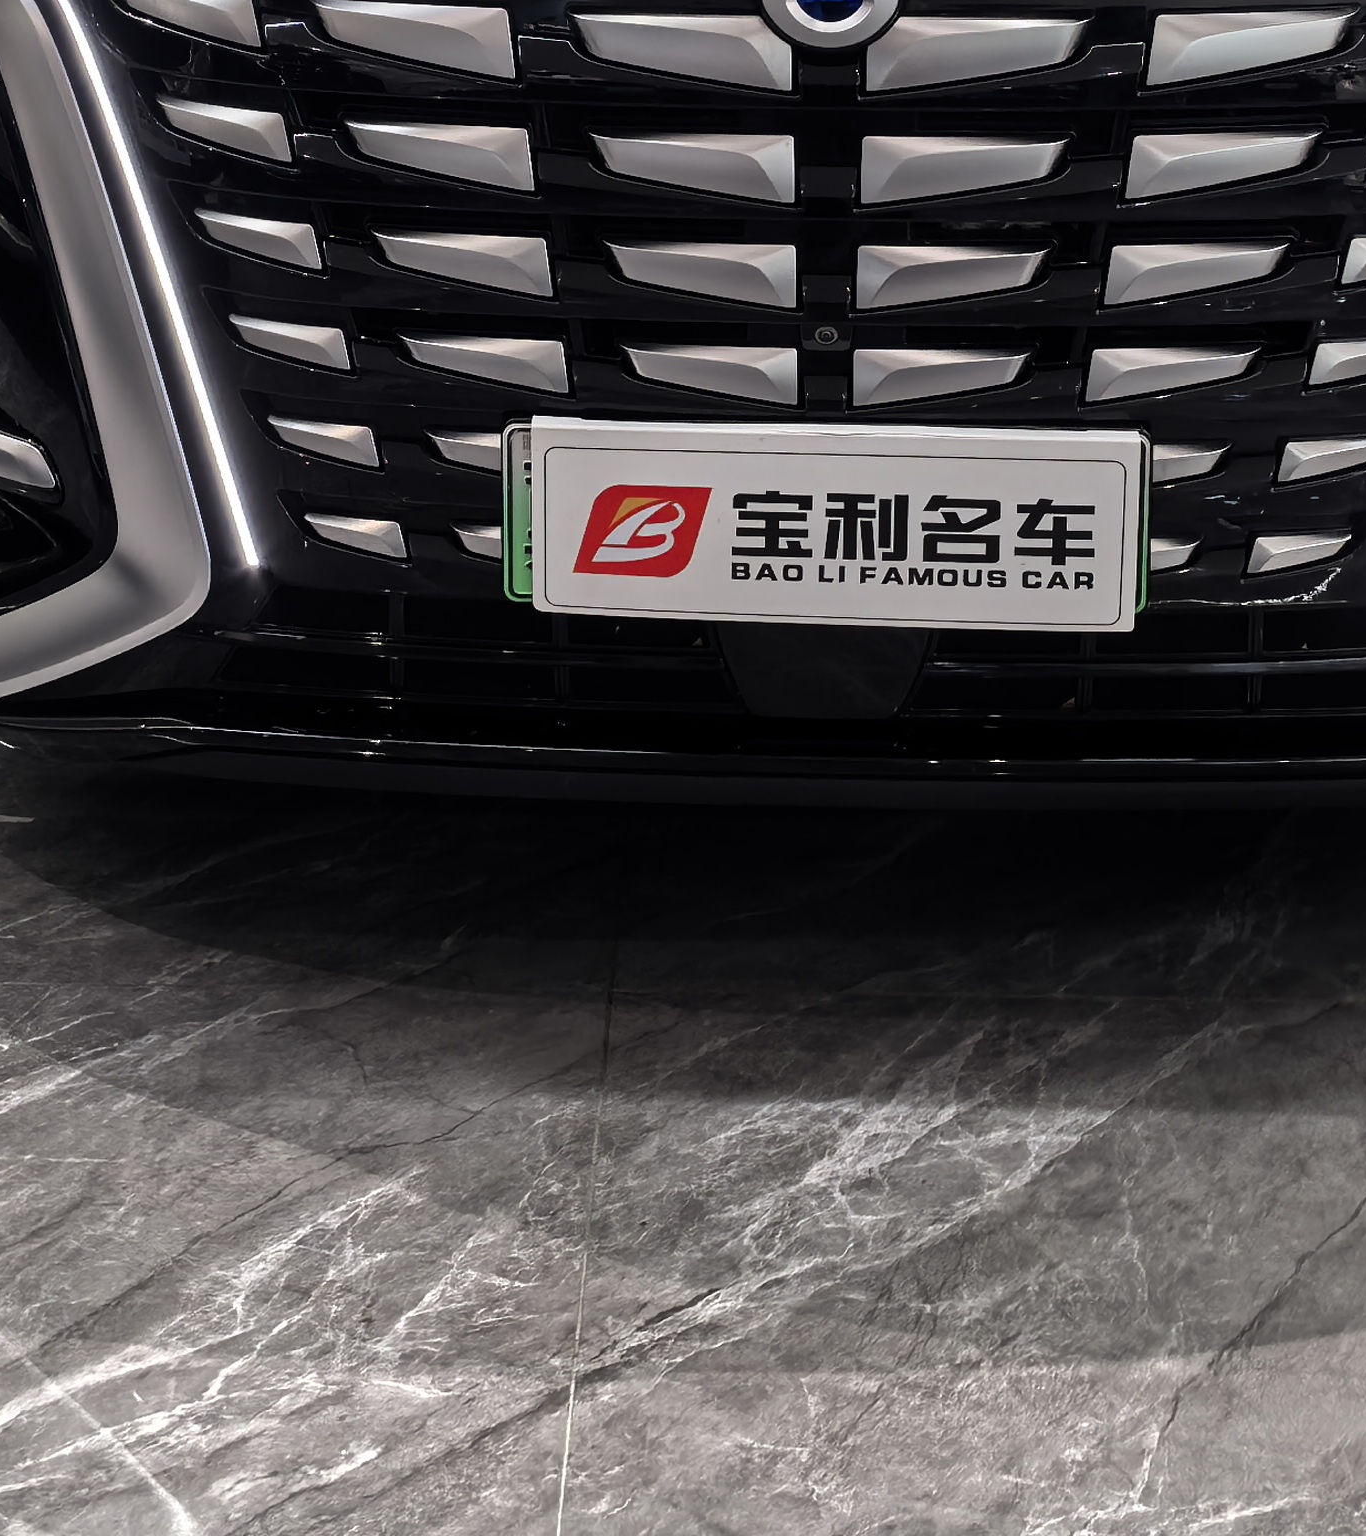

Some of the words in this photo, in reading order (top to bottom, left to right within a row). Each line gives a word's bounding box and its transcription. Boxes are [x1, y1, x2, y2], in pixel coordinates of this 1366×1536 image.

[731, 490, 1096, 566] 宝利名车
[731, 562, 803, 582] BAO
[818, 565, 846, 583] LI
[859, 566, 1008, 588] FAMOUS
[1022, 571, 1094, 590] CAR
